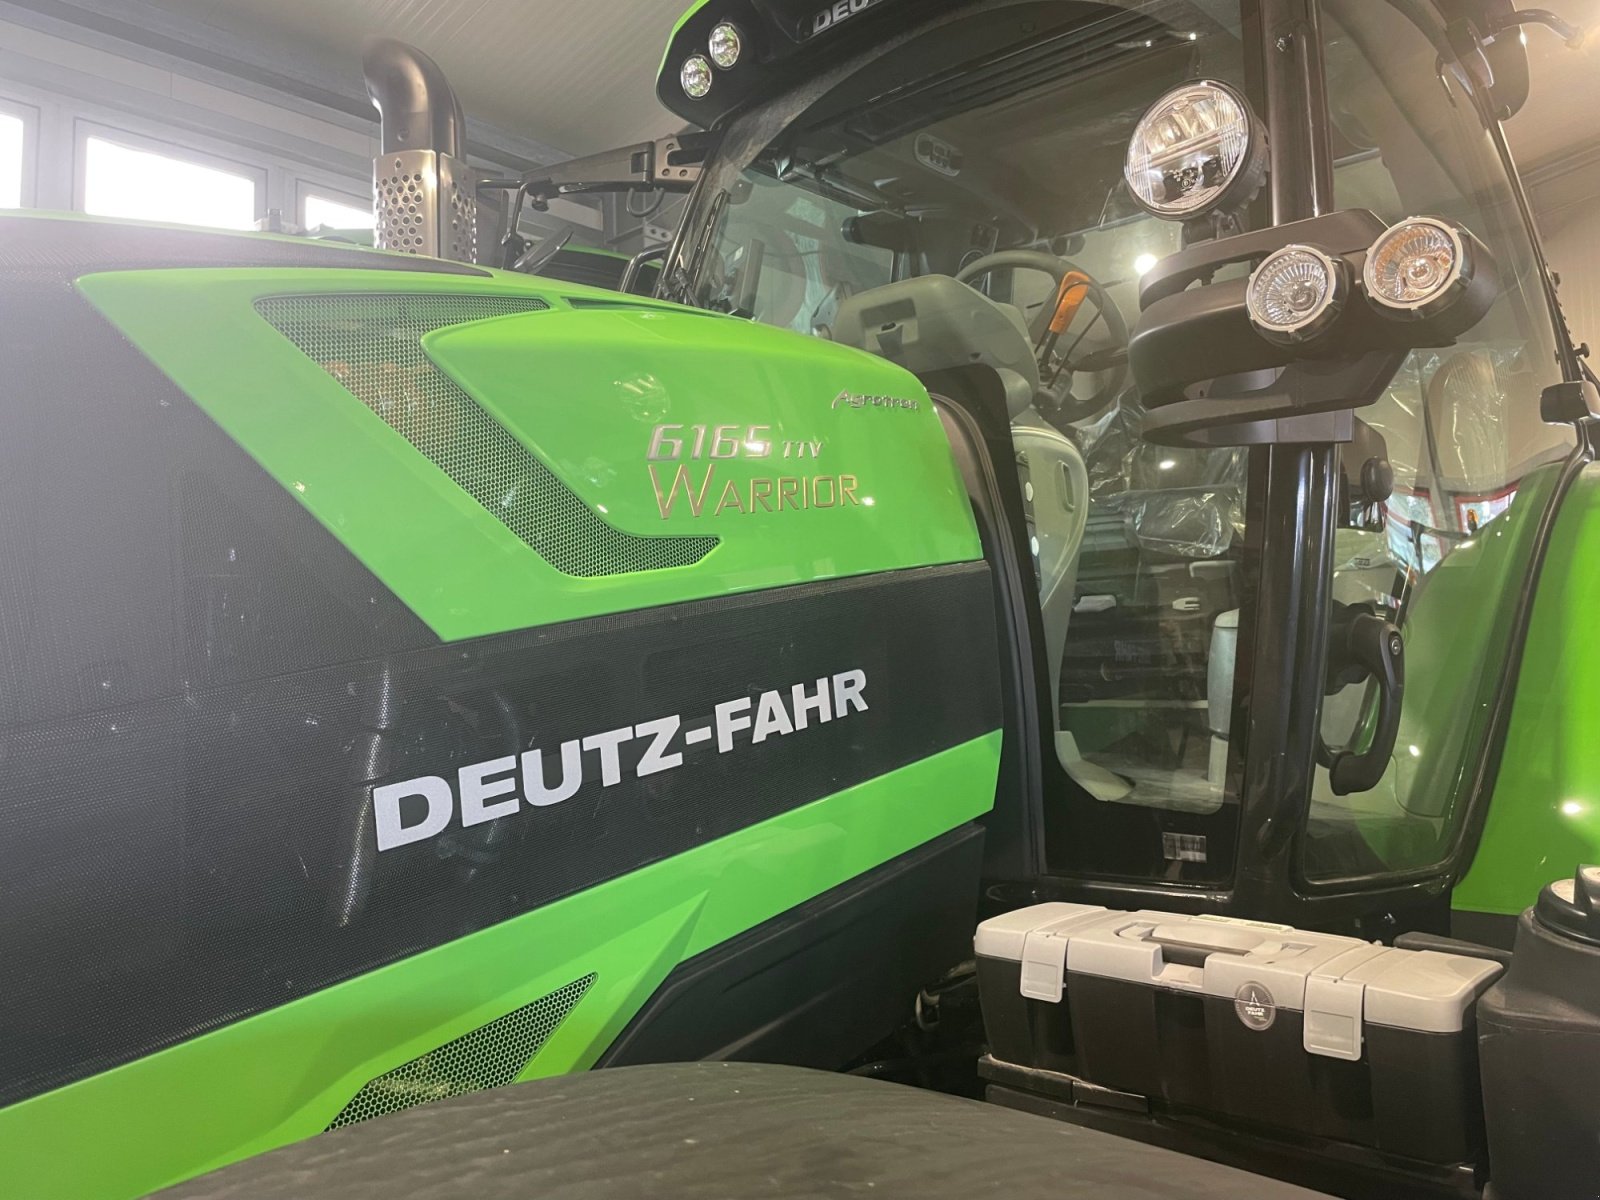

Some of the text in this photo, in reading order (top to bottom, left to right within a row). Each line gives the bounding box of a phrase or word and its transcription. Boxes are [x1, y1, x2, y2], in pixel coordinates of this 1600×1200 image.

[646, 423, 823, 461] 6165 TTV
[373, 668, 869, 852] DEUTZ-FAHR
